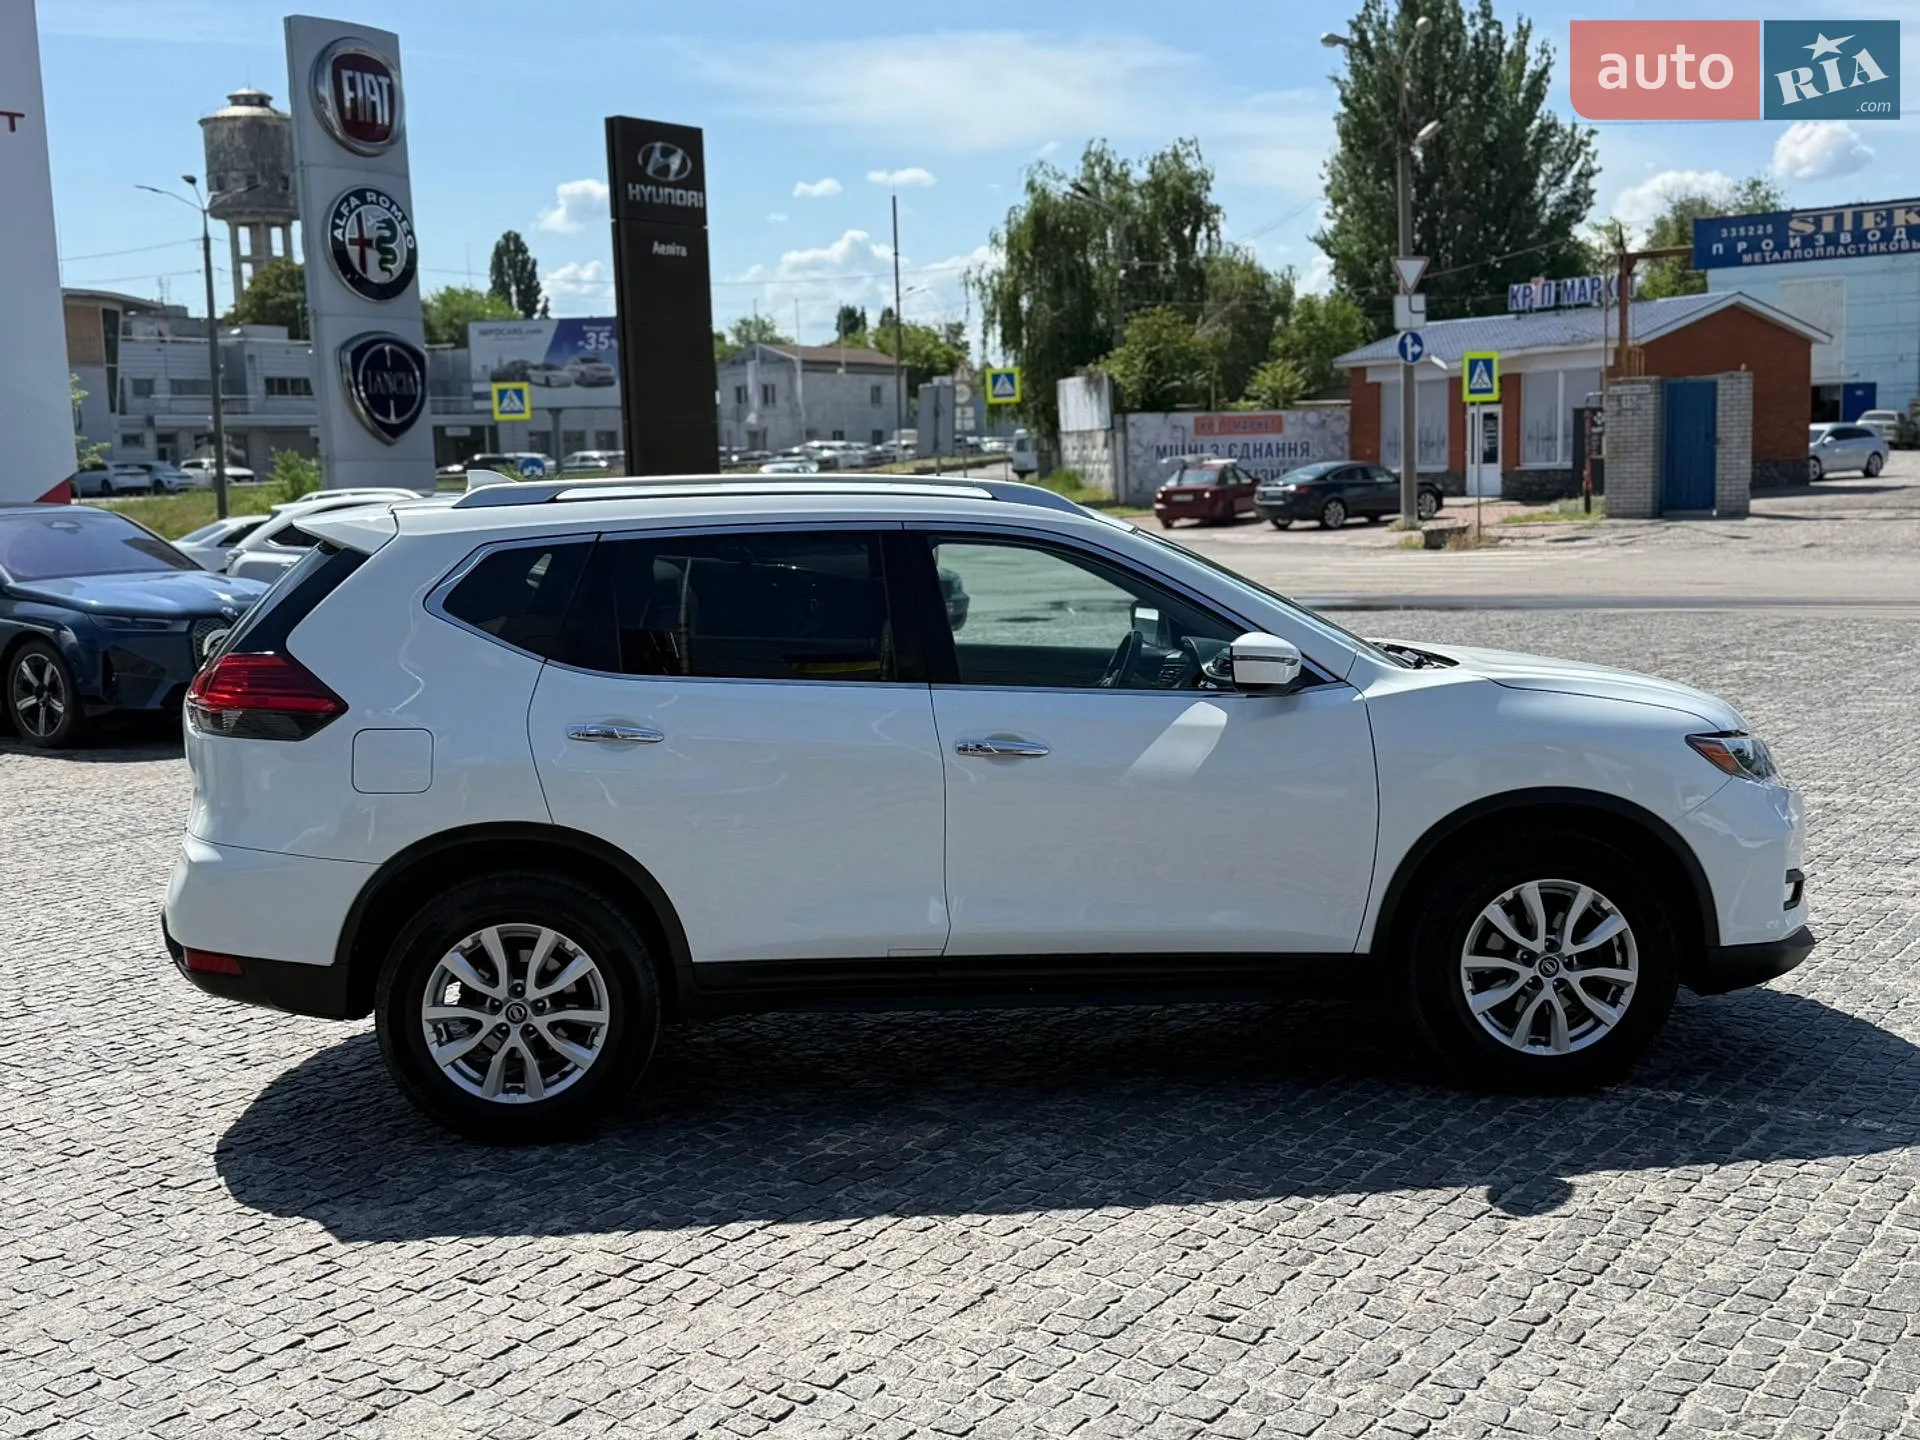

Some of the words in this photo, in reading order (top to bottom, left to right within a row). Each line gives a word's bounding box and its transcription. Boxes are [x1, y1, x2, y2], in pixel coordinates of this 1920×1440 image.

[341, 69, 391, 125] FIAT
[628, 183, 704, 208] HYUNDAI
[333, 196, 360, 241] ALFA
[366, 191, 415, 249] ROMEO
[1788, 203, 1920, 237] SITEK
